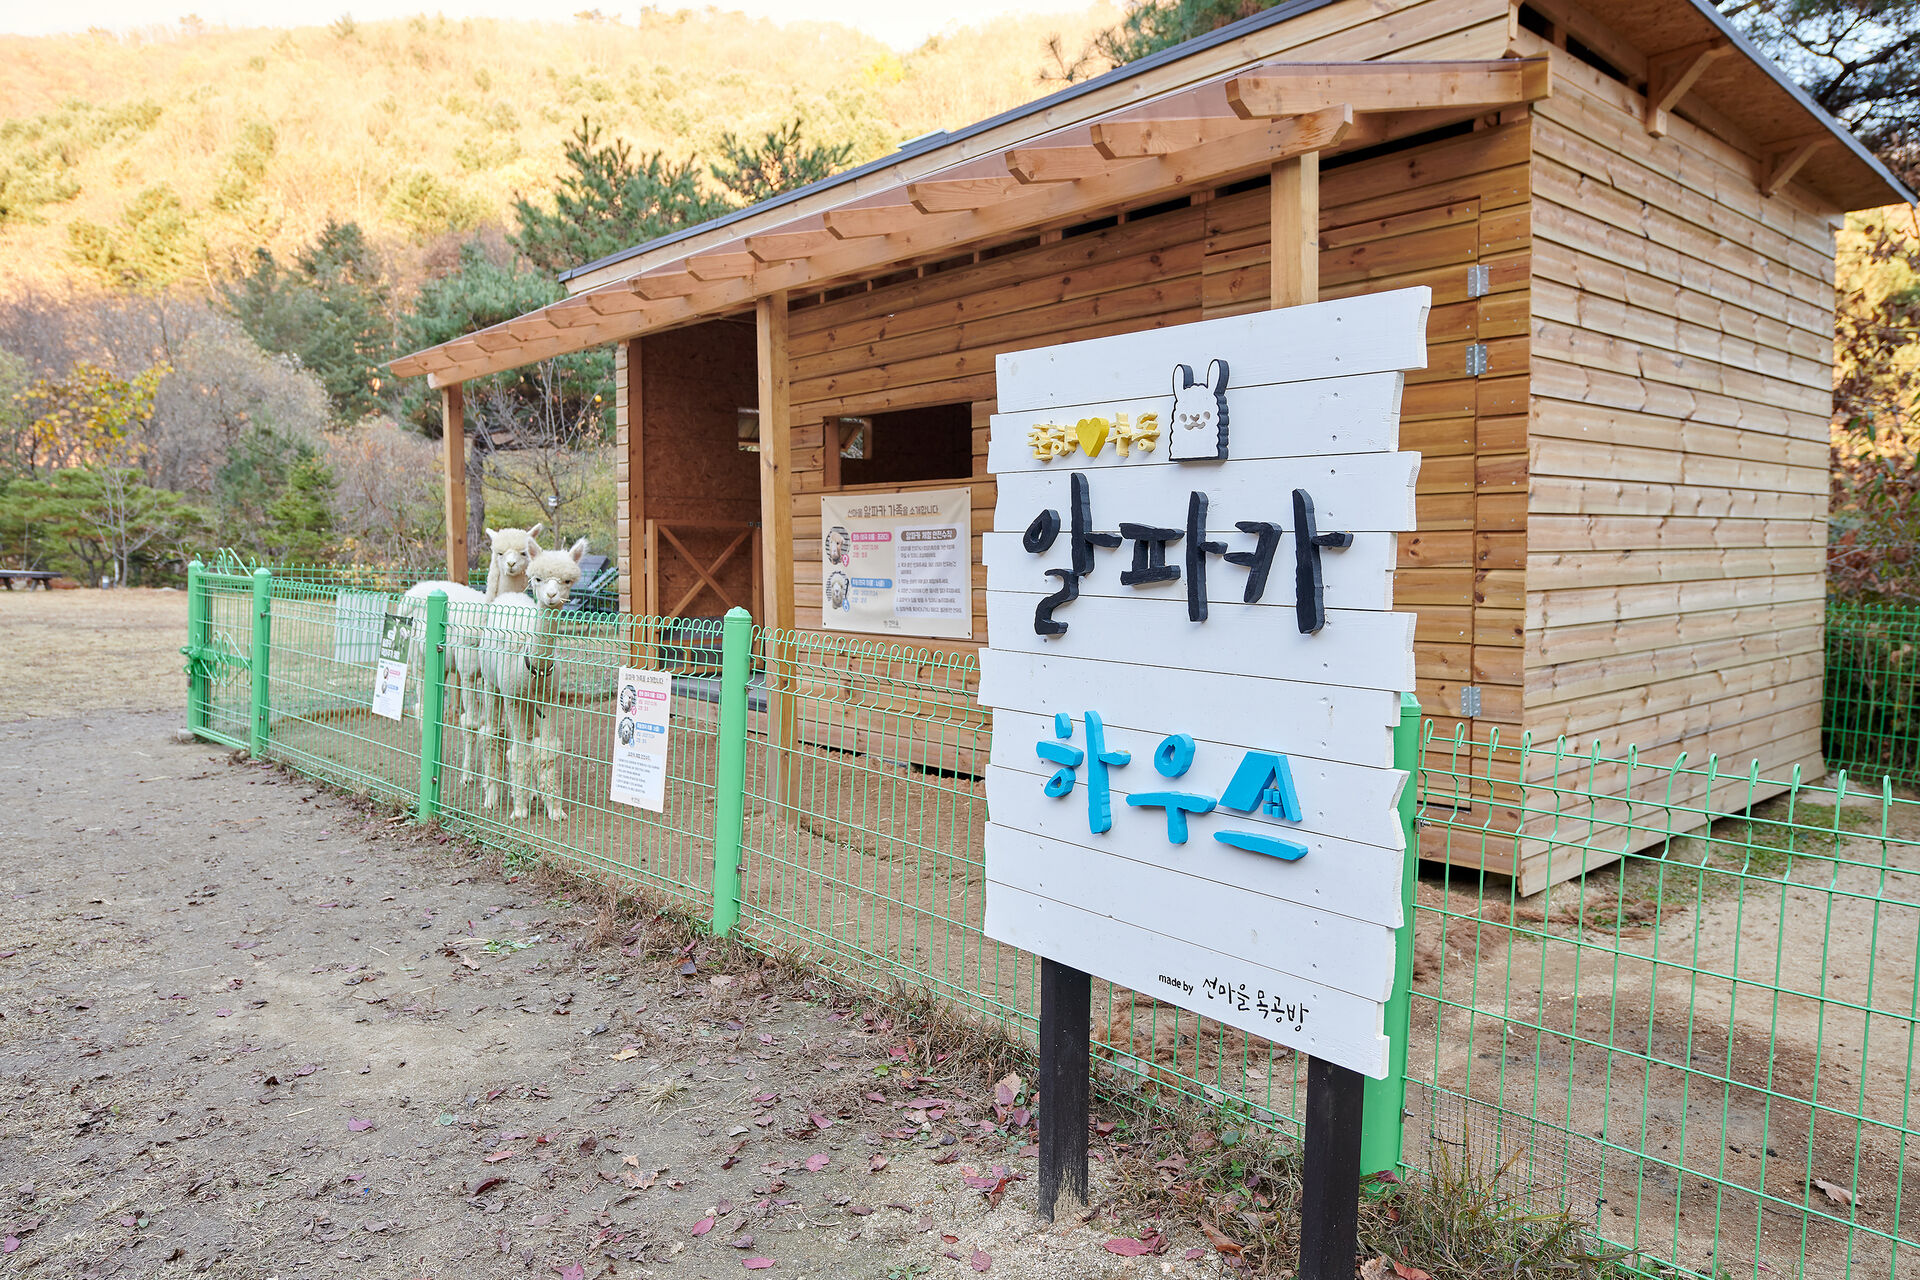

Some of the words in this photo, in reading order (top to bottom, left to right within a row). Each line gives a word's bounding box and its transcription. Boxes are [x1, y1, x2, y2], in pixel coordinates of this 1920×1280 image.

[863, 505, 886, 518] 알파카
[888, 503, 908, 517] 가족을
[909, 504, 939, 515] 소개합니다
[1023, 472, 1354, 635] 알파카
[1035, 710, 1309, 861] 하우스
[1158, 974, 1182, 989] made
[1182, 980, 1194, 996] by
[1202, 976, 1250, 1012] 선마을
[1256, 989, 1310, 1032] 목공방
